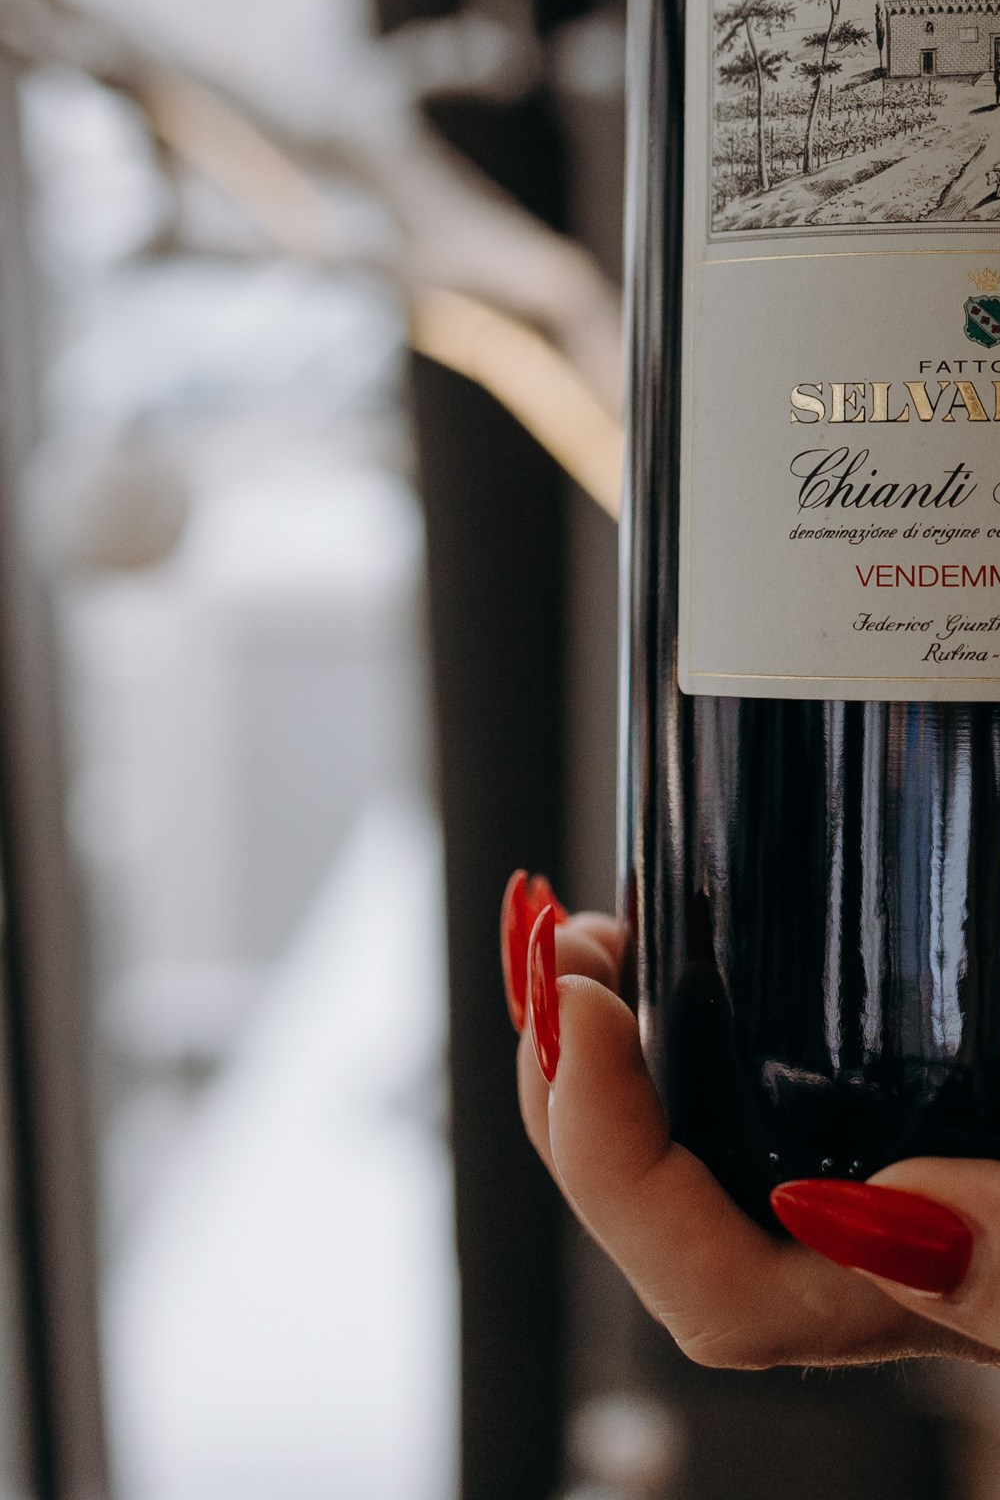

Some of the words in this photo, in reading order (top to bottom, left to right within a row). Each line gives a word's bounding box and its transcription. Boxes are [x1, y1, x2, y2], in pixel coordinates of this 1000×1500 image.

[789, 446, 979, 516] Chianti
[788, 523, 898, 545] denominazione
[902, 522, 921, 539] di
[922, 523, 981, 545] origine
[852, 612, 934, 632] Federico
[921, 642, 988, 664] Rufina
